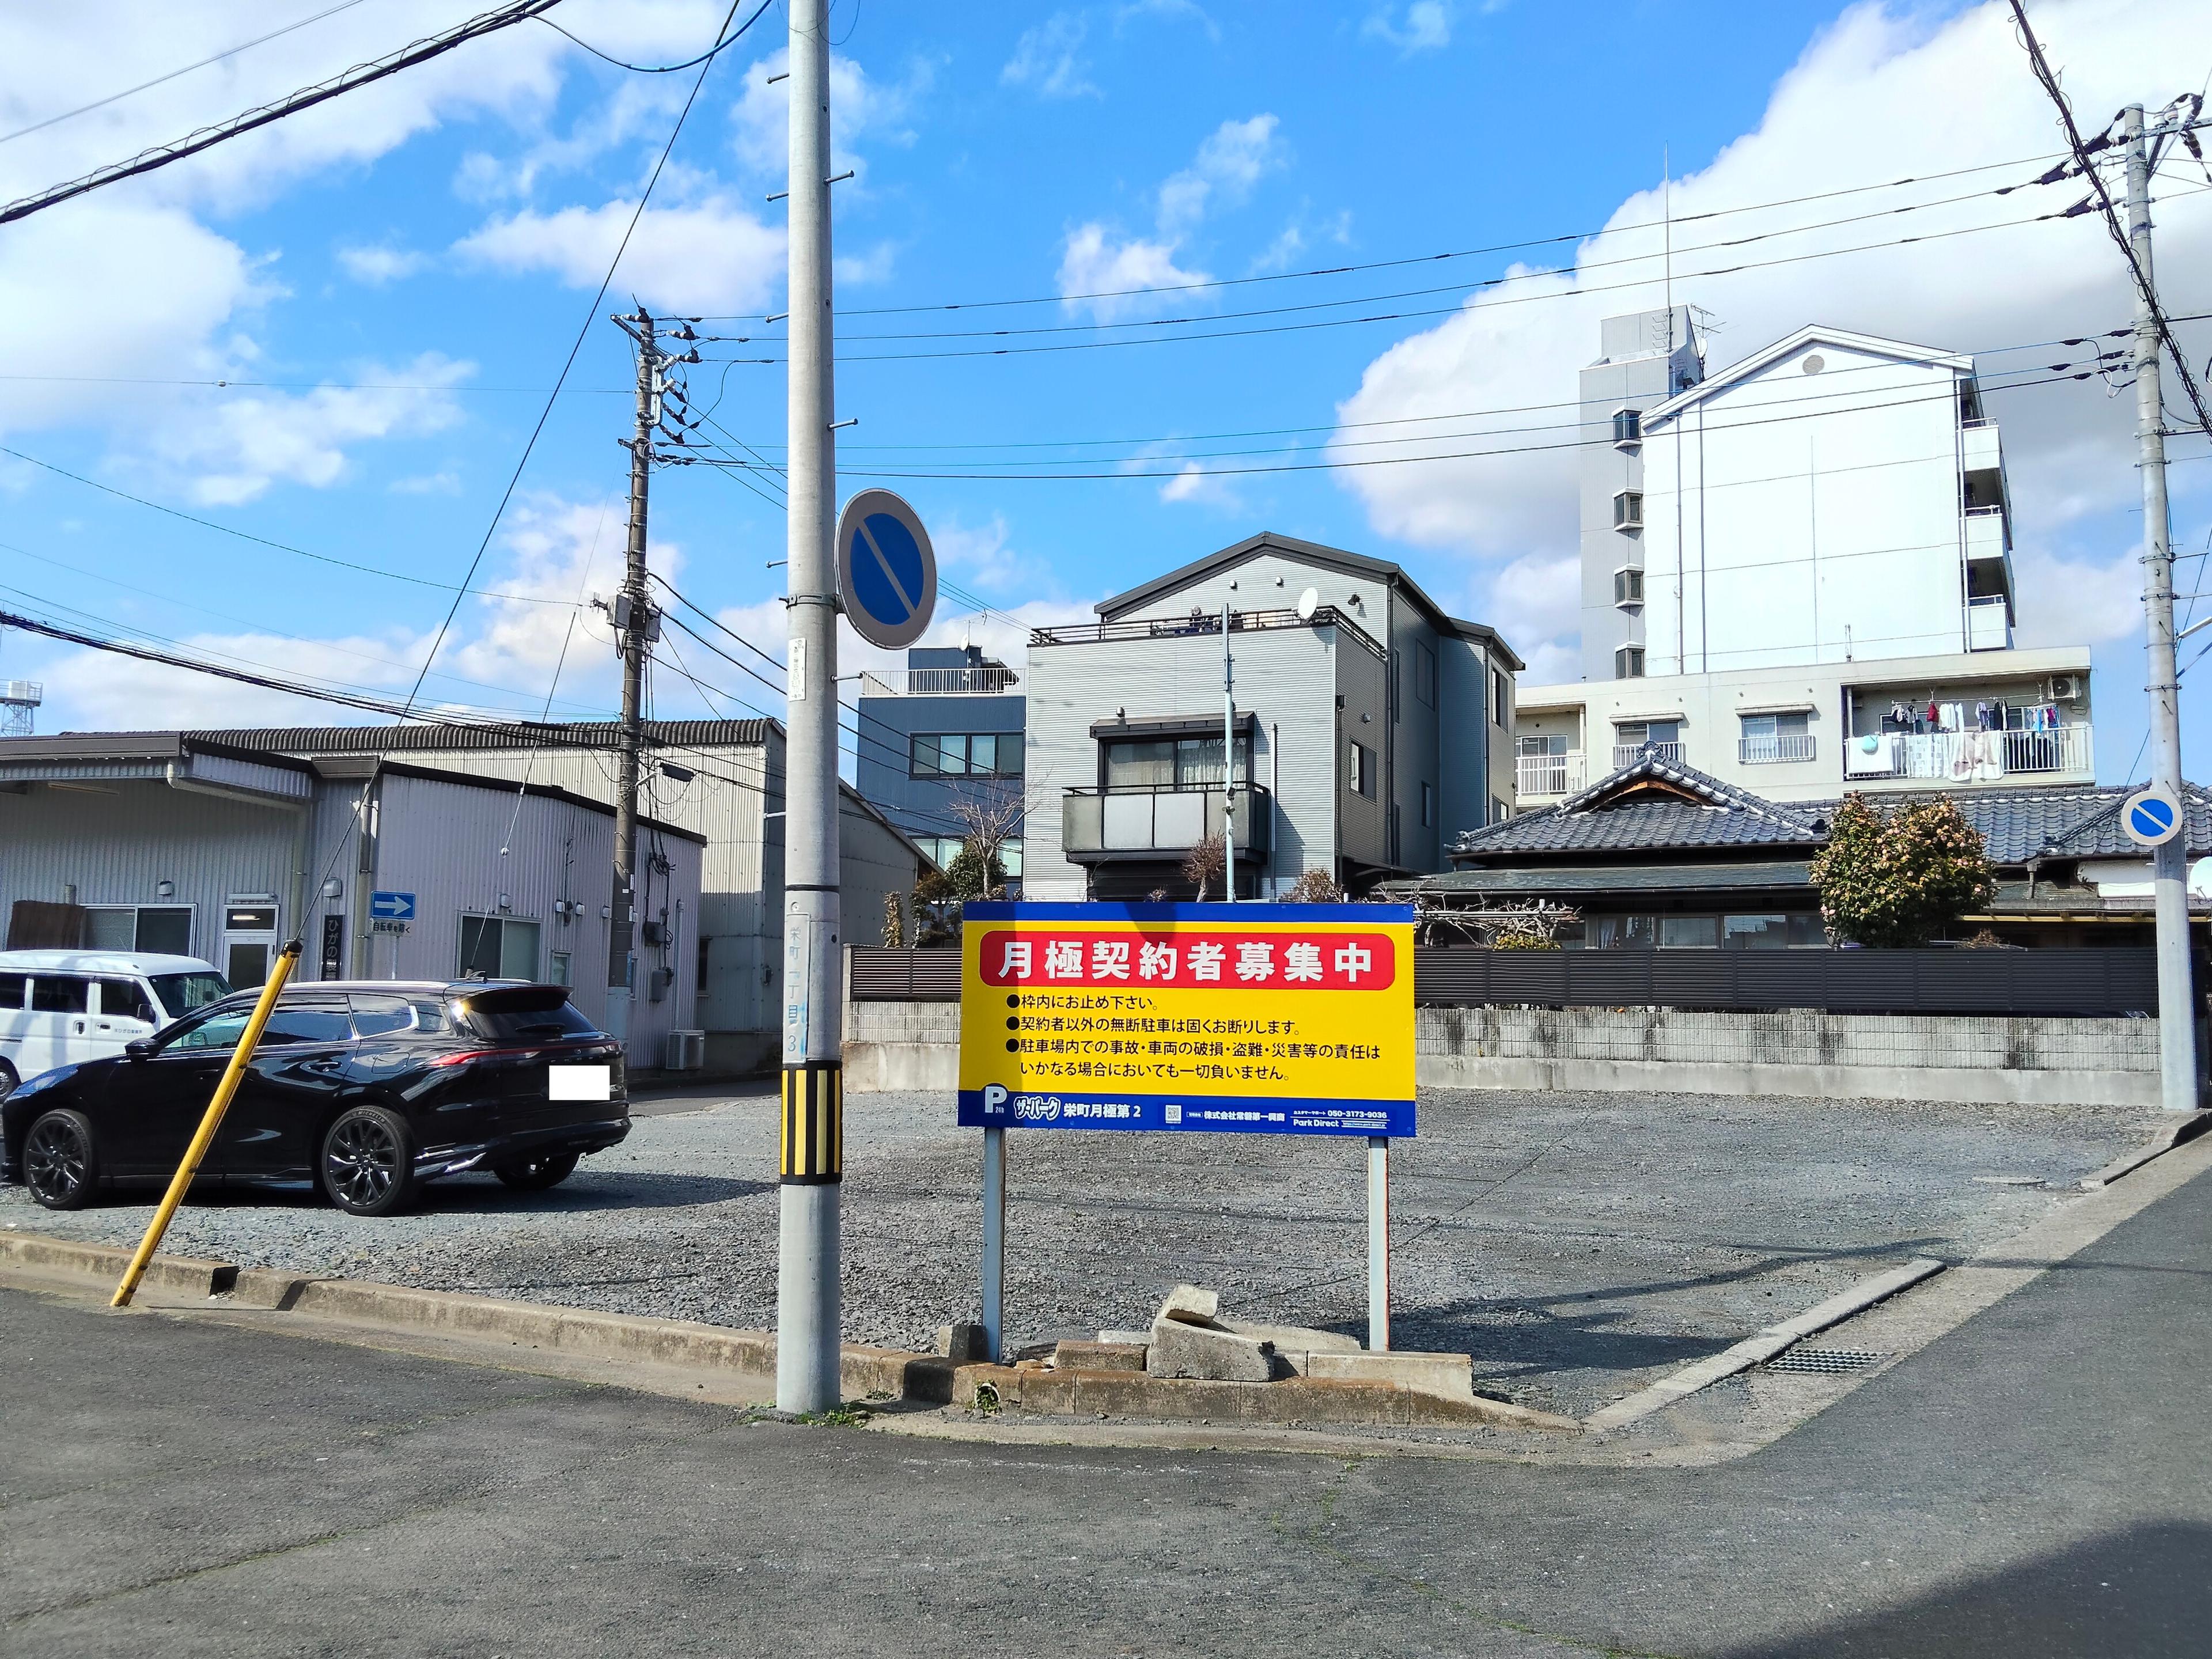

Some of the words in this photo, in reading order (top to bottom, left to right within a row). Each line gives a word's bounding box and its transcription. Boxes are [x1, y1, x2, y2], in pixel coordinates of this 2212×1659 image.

[998, 940, 1372, 983] 月極契約者募集中
[1021, 994, 1157, 1010] 枠内にお止め下さい。
[1020, 1016, 1300, 1036] 契約者以外の無断駐車は固くお断りします。
[1020, 1061, 1289, 1081] いかなる場合においても一切負いません。
[984, 1086, 1007, 1113] P
[358, 1111, 385, 1123] MICHELIN
[1314, 1119, 1339, 1127] Direct
[1328, 1110, 1387, 1119] 050-3173-9036
